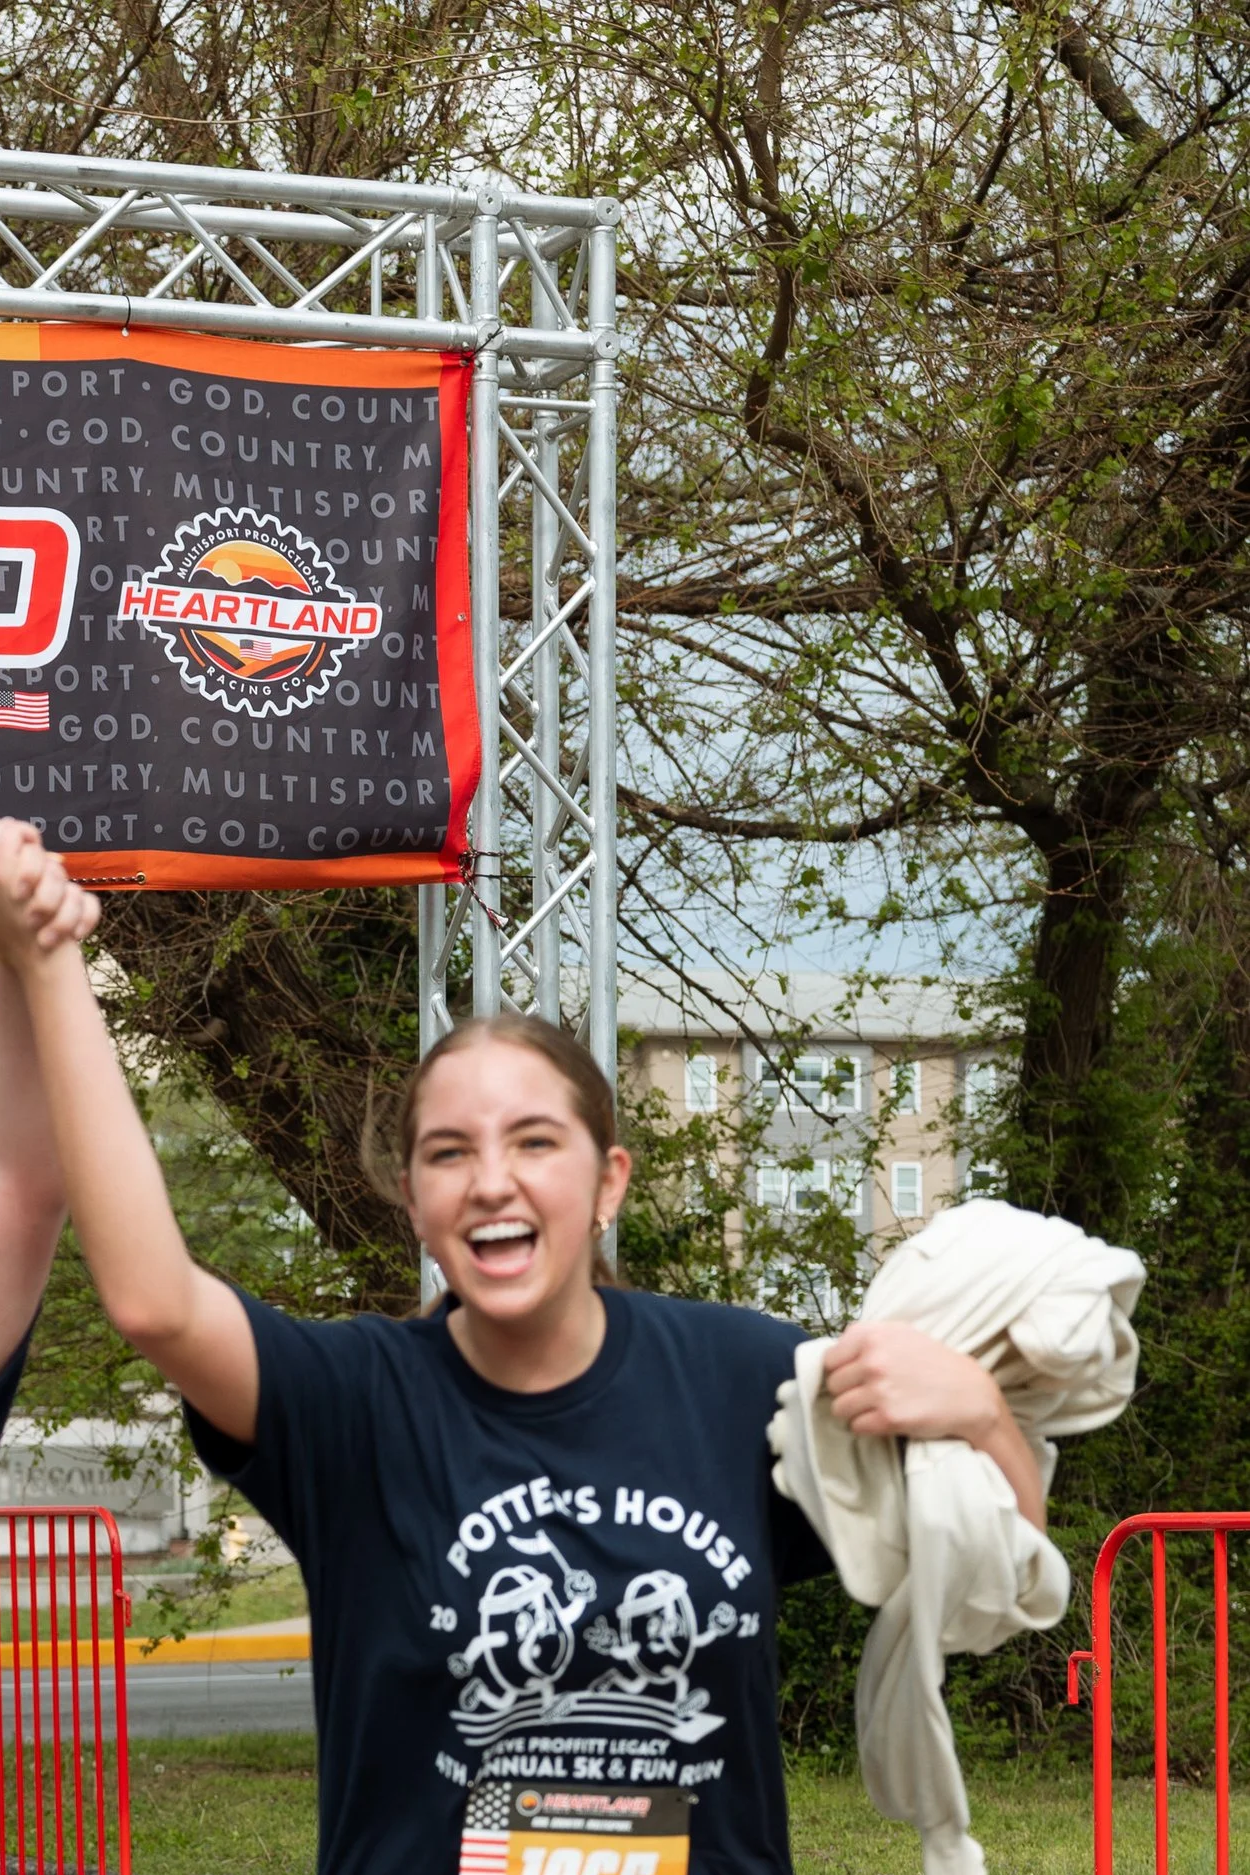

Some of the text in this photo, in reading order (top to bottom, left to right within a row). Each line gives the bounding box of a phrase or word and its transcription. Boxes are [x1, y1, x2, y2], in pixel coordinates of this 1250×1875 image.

[169, 377, 270, 419] GOD,
[46, 416, 149, 448] GOD,
[171, 425, 383, 473] COUNTRY,
[173, 472, 441, 518] MULTISPOR
[177, 527, 240, 580] MULTISPORT
[244, 529, 323, 594] PRODUCTIONS
[120, 584, 380, 636] HEARTLAND
[206, 665, 273, 696] RACING
[59, 713, 159, 743] GOD,
[181, 717, 396, 759] COUNTRY,
[182, 816, 286, 853] GOD,
[614, 1486, 753, 1591] HOUSE
[429, 1604, 458, 1632] 20
[572, 1757, 605, 1780] 5K
[607, 1759, 626, 1780] &
[630, 1758, 678, 1782] FUN
[679, 1758, 725, 1787] RUN
